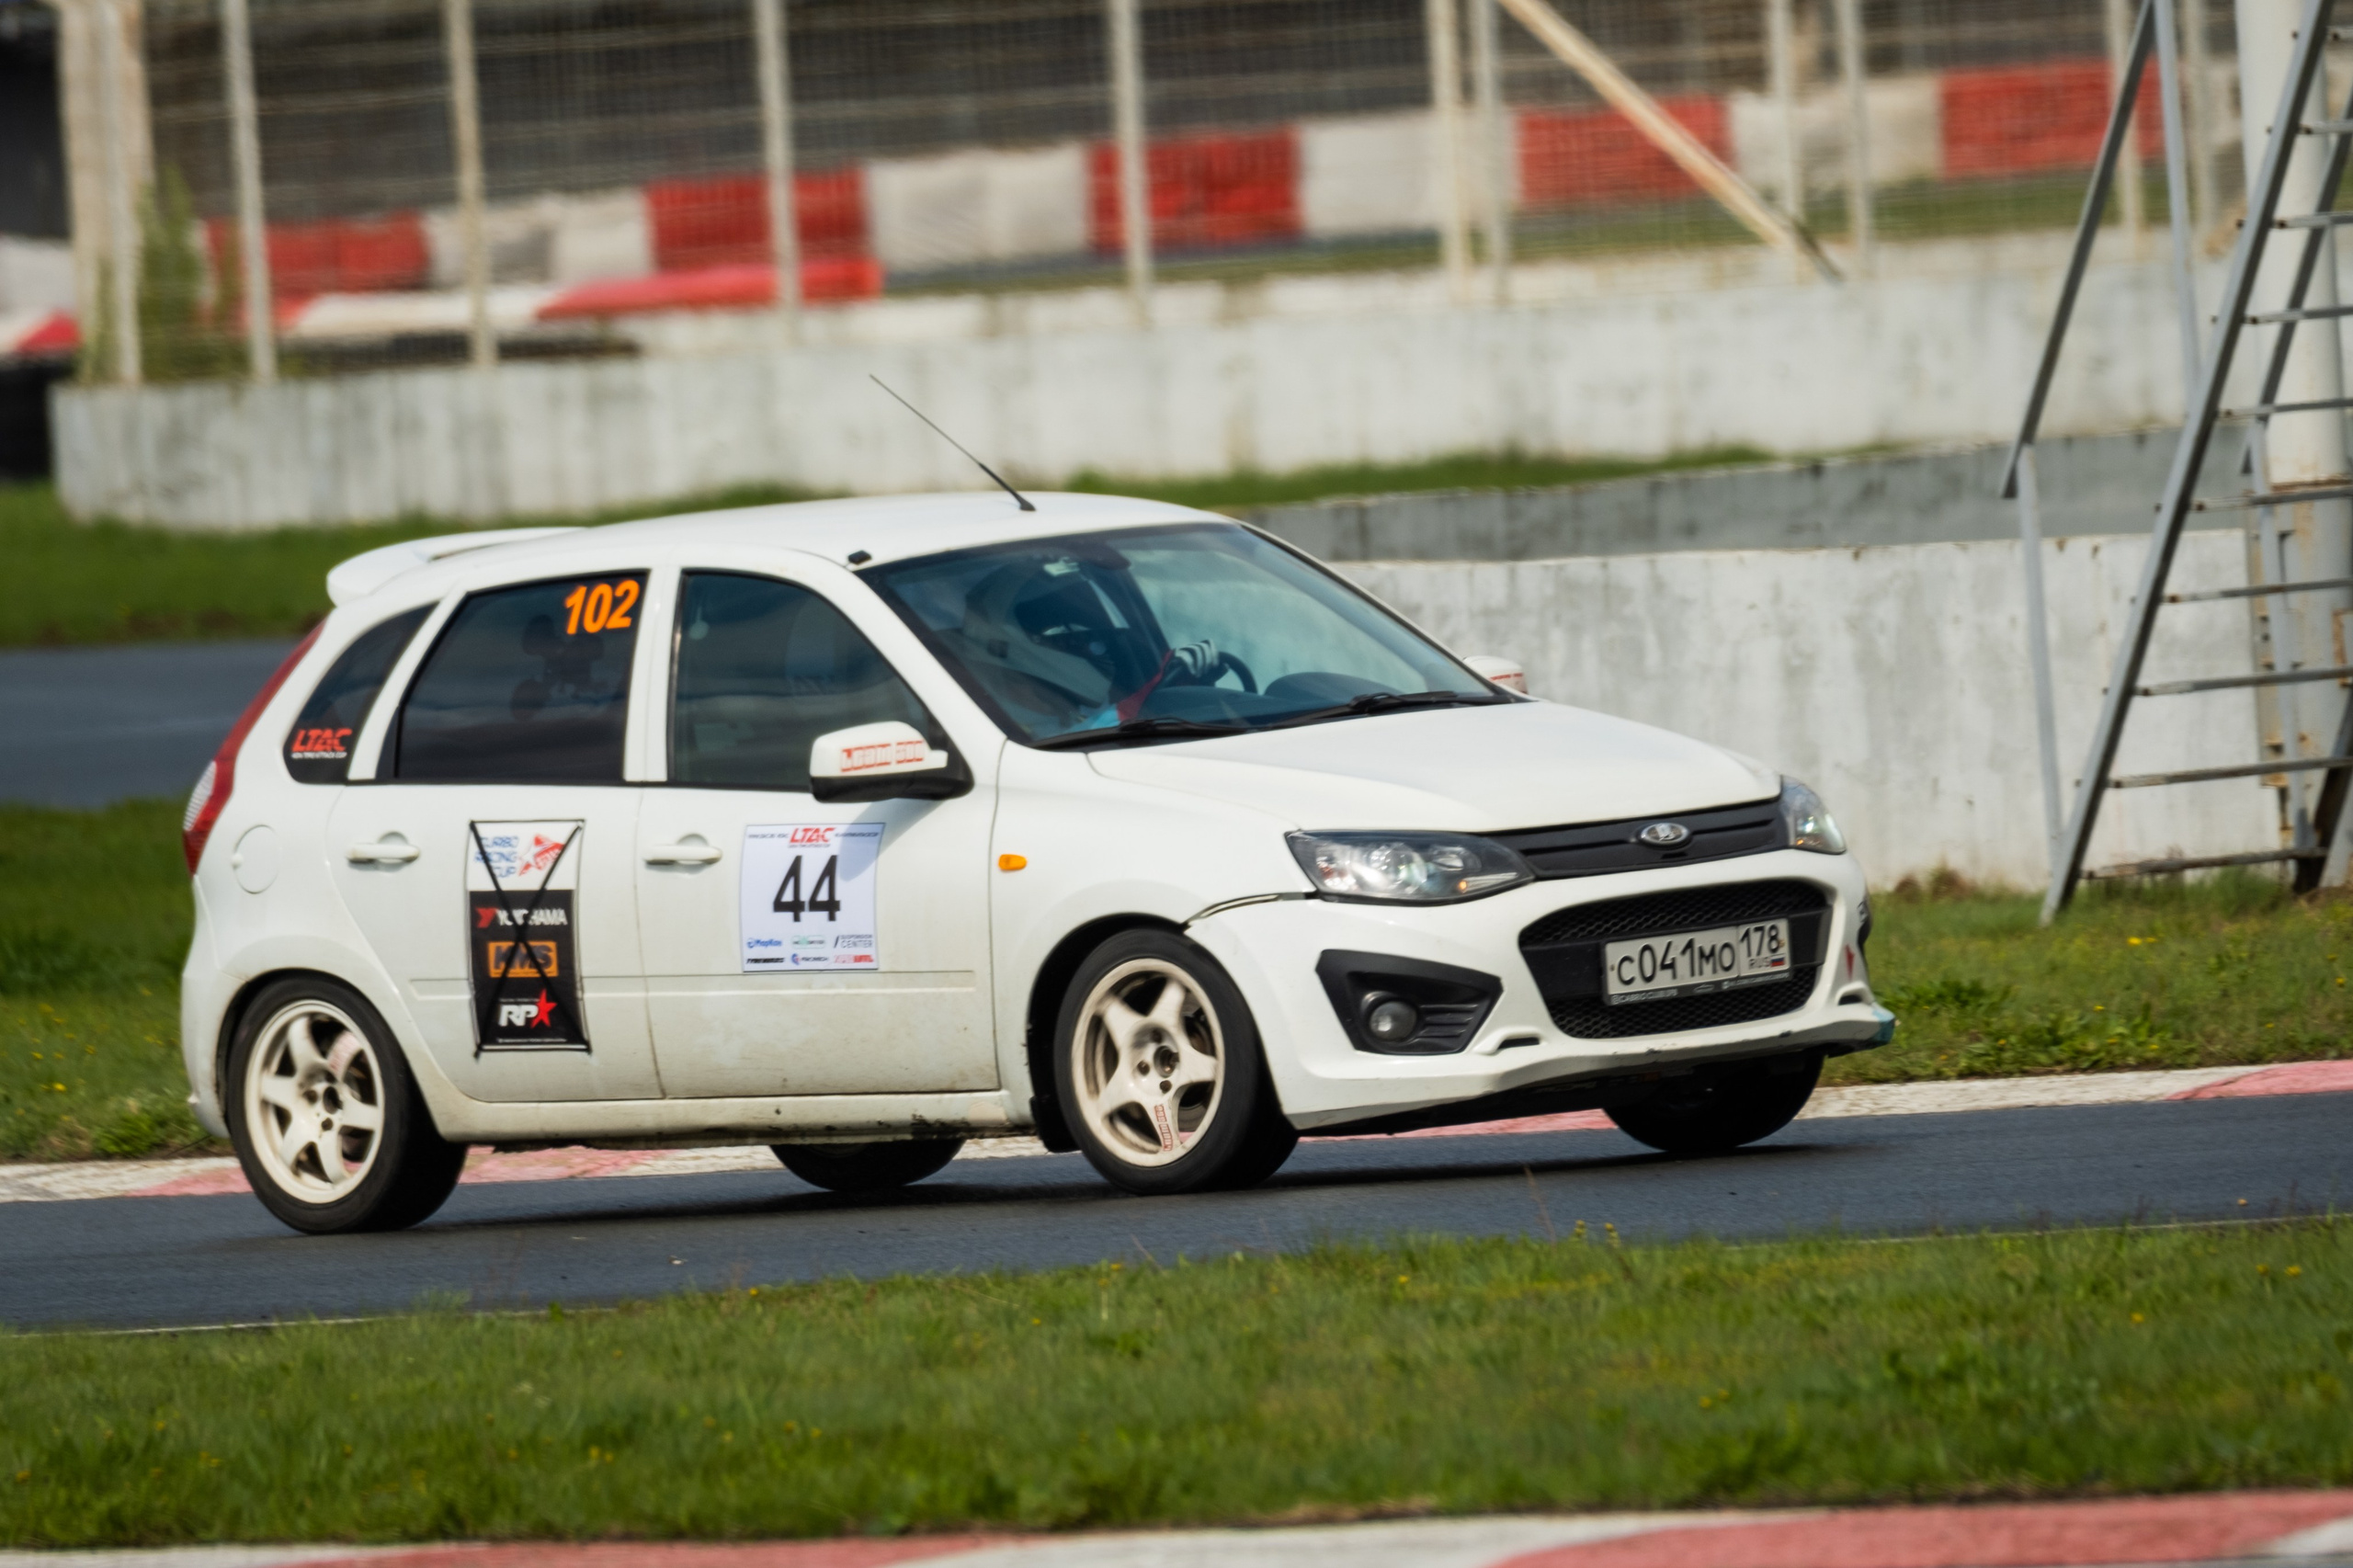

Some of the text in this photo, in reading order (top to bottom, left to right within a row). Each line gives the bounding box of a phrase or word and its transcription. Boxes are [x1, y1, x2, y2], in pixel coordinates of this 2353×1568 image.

[564, 579, 640, 635] 102
[290, 728, 353, 752] LTAC
[790, 827, 836, 843] LTAC
[773, 855, 841, 922] 44
[1617, 937, 1735, 986] C041MO
[1739, 924, 1779, 958] 178
[1749, 957, 1770, 970] RUS
[498, 1005, 539, 1027] RP
